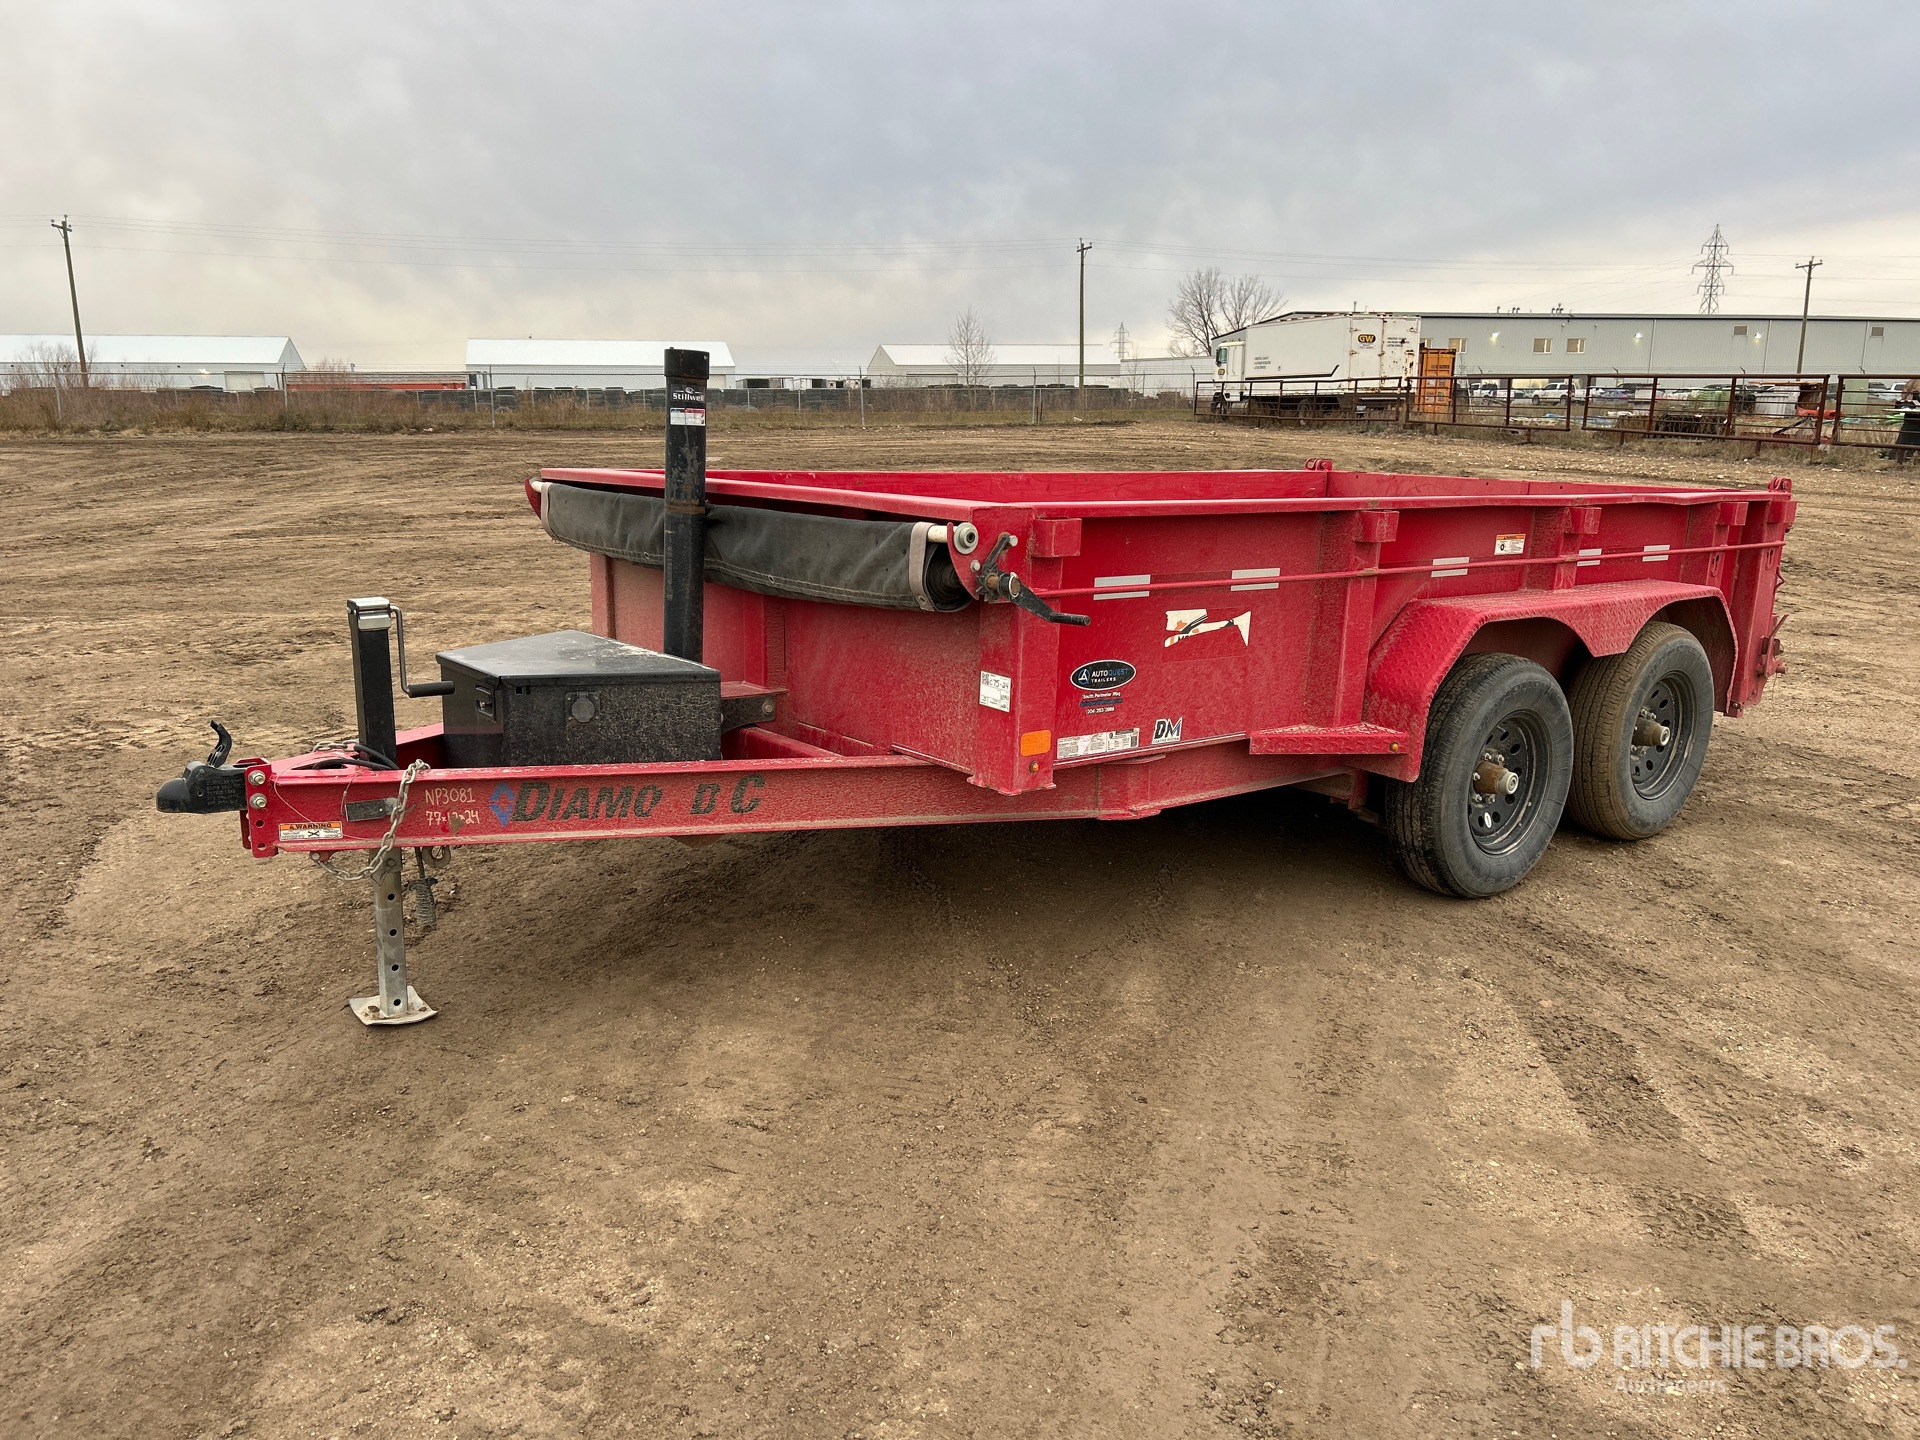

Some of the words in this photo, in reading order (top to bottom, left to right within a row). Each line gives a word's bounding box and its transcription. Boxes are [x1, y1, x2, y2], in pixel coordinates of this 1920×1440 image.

[1091, 668, 1129, 678] AUTOQUEST
[1154, 720, 1181, 739] DM
[425, 787, 476, 806] NP3081
[730, 773, 766, 813] C
